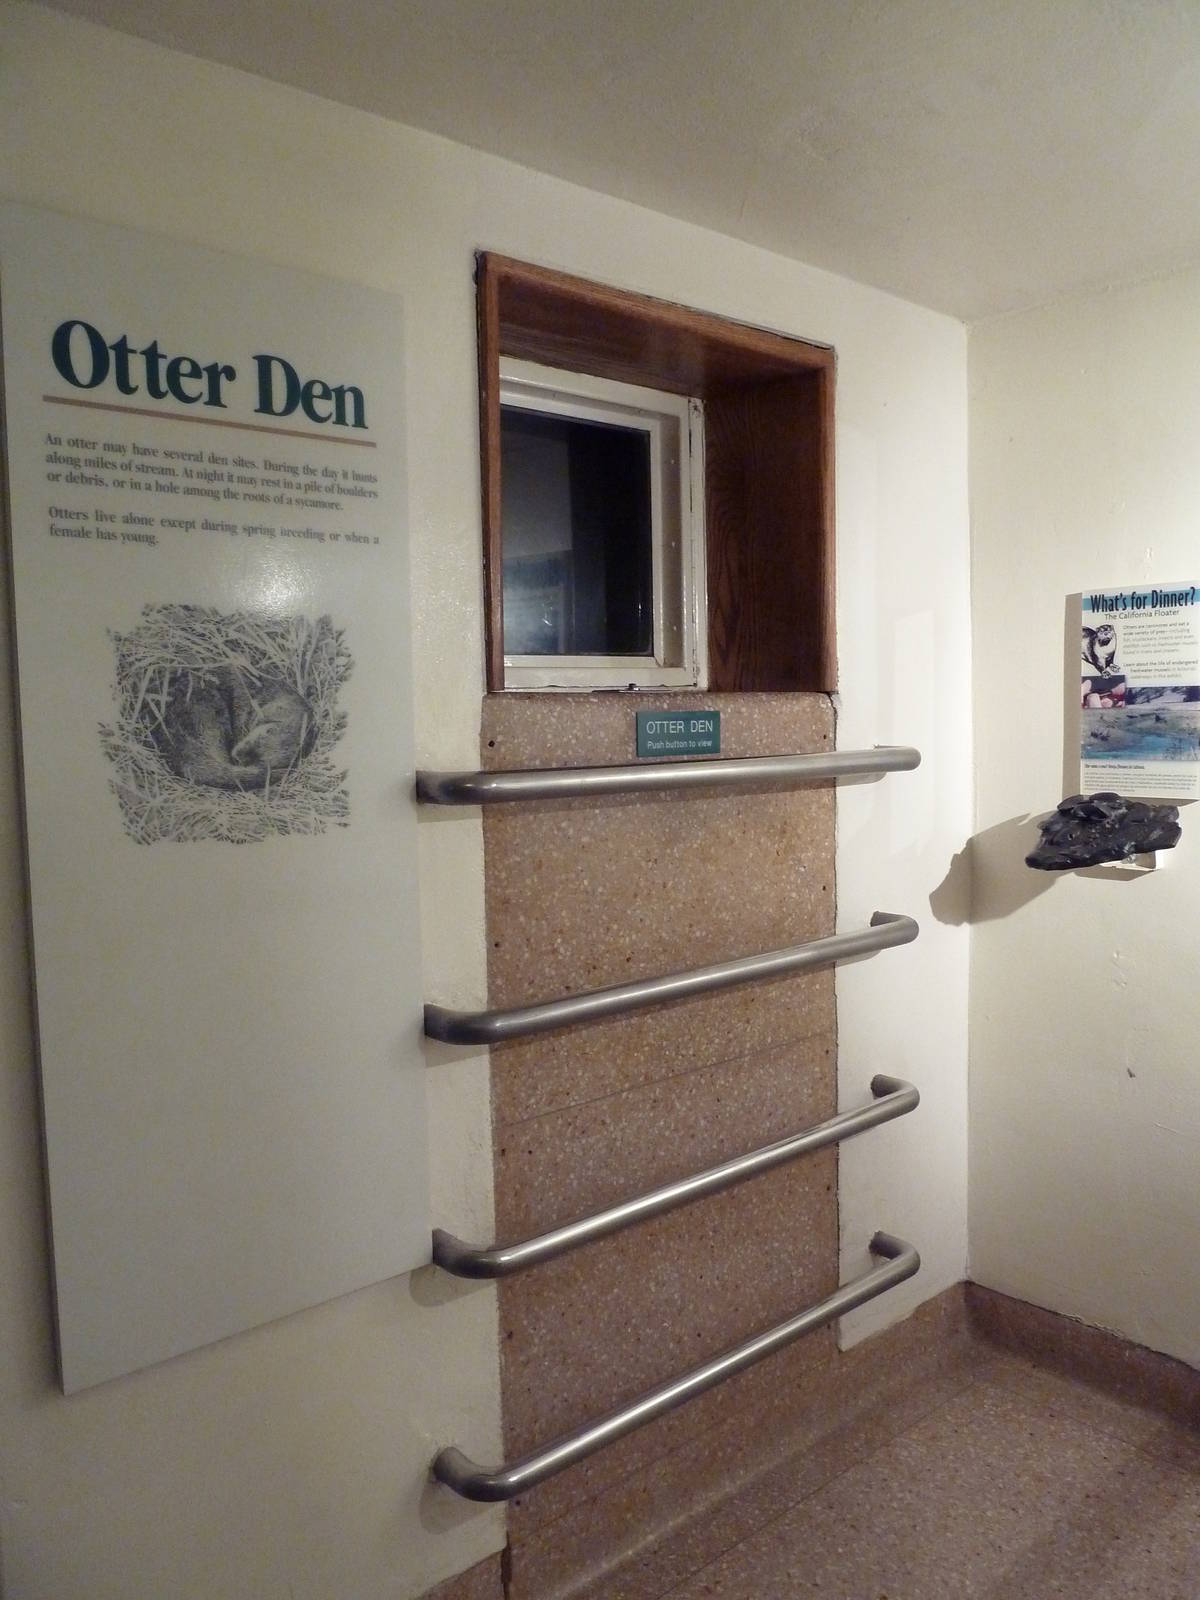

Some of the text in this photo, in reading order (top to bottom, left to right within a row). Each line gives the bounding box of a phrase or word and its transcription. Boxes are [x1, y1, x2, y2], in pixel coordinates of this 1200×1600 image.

[52, 320, 368, 429] Otter Den
[45, 433, 378, 483] An otter may have several den sites. During the day it hunts
[45, 452, 378, 499] along miles of stream. At night it may rest in a pile of boulders
[47, 473, 62, 482] or
[113, 479, 126, 489] or
[130, 478, 141, 490] in
[145, 481, 153, 491] a
[155, 480, 180, 494] hole
[182, 487, 220, 501] among
[223, 488, 240, 499] the
[243, 492, 271, 503] roots
[273, 494, 286, 504] of
[287, 496, 293, 505] a
[295, 498, 344, 511] sycamore.
[49, 506, 89, 520] Otters
[95, 509, 117, 523] live
[122, 512, 154, 526] alone
[160, 517, 196, 532] except
[201, 519, 238, 536] during
[243, 524, 276, 538] spring
[329, 533, 341, 541] or
[344, 532, 370, 544] when
[373, 536, 379, 544] a
[50, 523, 159, 547] female has young.
[1090, 586, 1196, 613] What's for Dinner?
[1104, 609, 1180, 621] The California Floater
[646, 720, 713, 735] OTTER DEN
[647, 741, 664, 750] Push
[665, 741, 688, 749] button
[697, 740, 713, 748] view
